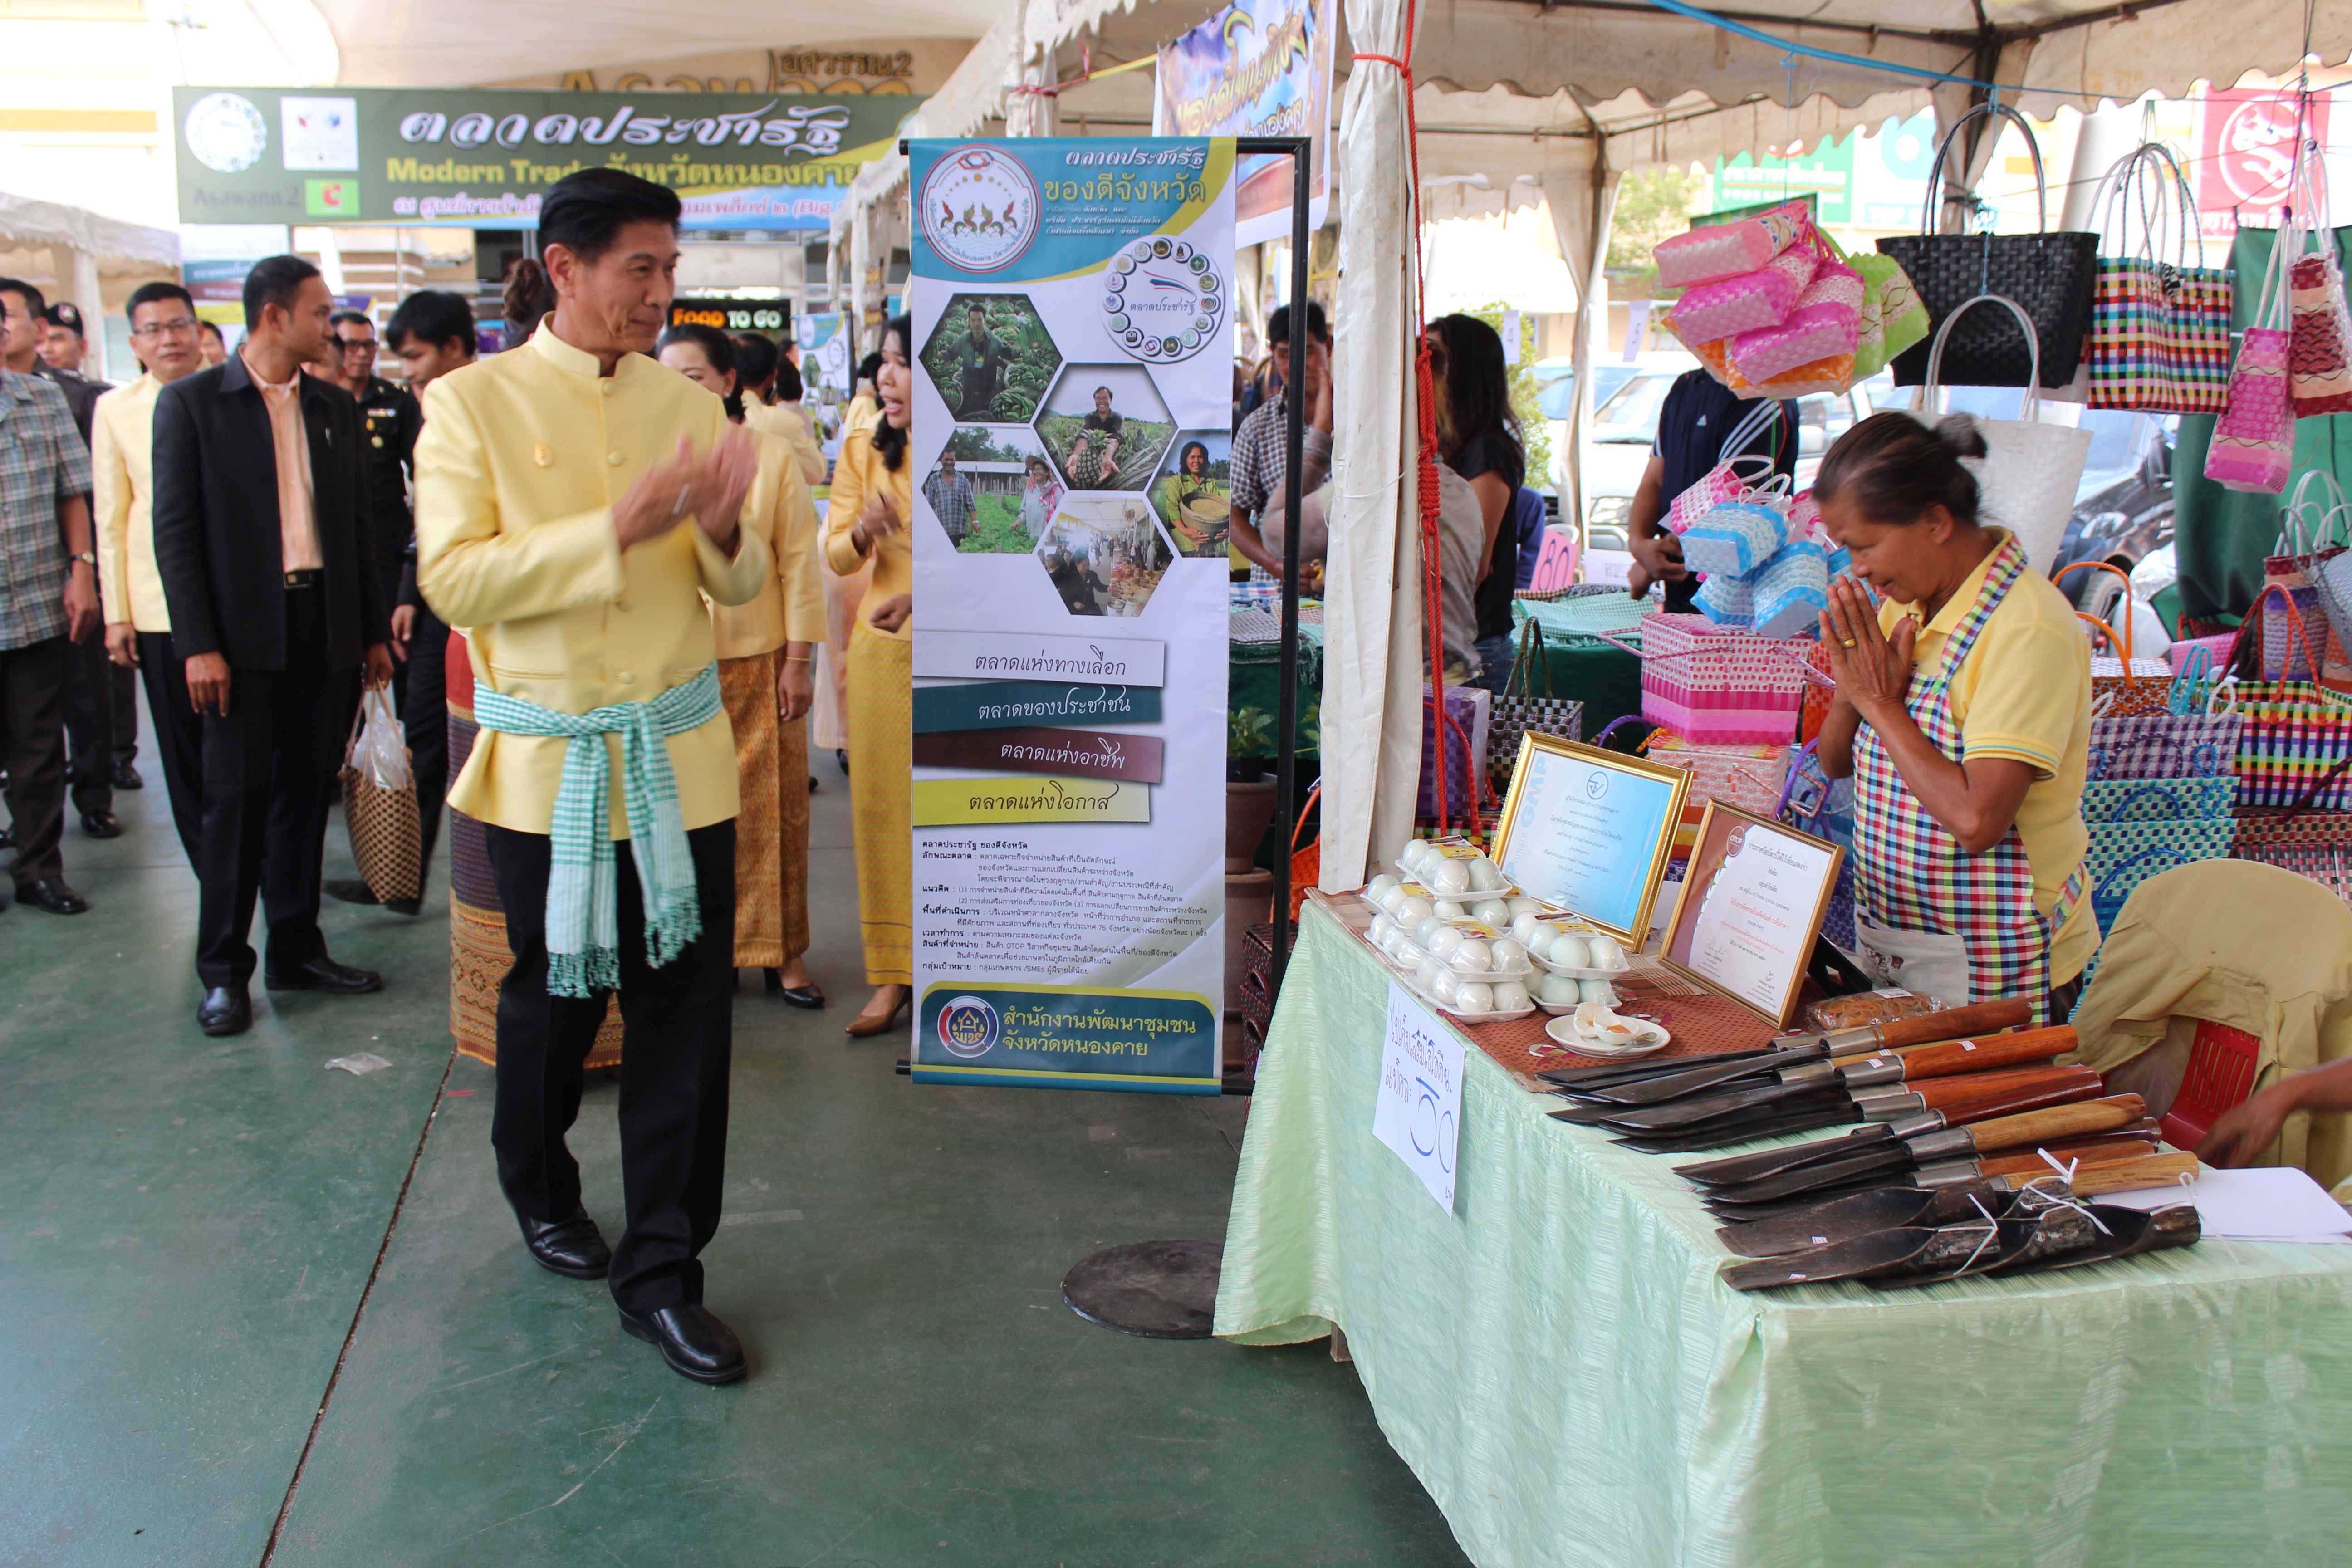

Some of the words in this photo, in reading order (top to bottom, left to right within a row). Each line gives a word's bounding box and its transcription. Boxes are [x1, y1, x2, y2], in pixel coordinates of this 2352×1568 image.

[400, 98, 852, 157] ตลาดประชารัฐ
[1066, 144, 1205, 170] ตลาดประชารัฐ
[386, 157, 505, 183] Modern
[510, 159, 594, 184] Trad
[1044, 172, 1206, 201] ของดีจังหวัด
[673, 308, 725, 328] FOOD
[727, 310, 752, 329] TO
[753, 309, 782, 329] GO
[1130, 296, 1196, 315] ตลาดประชารัฐ
[1539, 539, 1570, 590] 80
[975, 644, 1126, 676] ตลาดแห่งทางเลือก
[978, 685, 1131, 720] ตลาดของประชาชน
[1000, 737, 1125, 769] ตลาดแห่งอาชีพ
[970, 780, 1120, 811] ตลาดแห่งโอกาส
[922, 840, 976, 850] ตลาดประชารัฐ
[980, 841, 1028, 849] ของดีจังหวัด
[1730, 834, 1743, 844] OTOP
[922, 851, 972, 859] ลักษณะตลาด
[1505, 833, 1529, 879] Primary
[922, 884, 949, 892] แนวคิด
[958, 886, 967, 894] (1)
[922, 904, 980, 915] พื้นที่ดำเนินการ
[922, 928, 964, 936] เวลาทำการ
[1063, 921, 1096, 930] ทั่วประเทศ
[922, 938, 978, 948] สินค้าที่จำหน่าย
[986, 941, 1003, 949] สินค้า
[1027, 942, 1071, 952] วิสาหกิจชุมชน
[922, 962, 971, 971] กลุ่มเป้าหมาย
[979, 964, 1021, 973] กลุ่มเกษตรกร
[1003, 1005, 1196, 1039] สำนักงานพัฒนาชุมชน
[1002, 1029, 1148, 1056] จังหวัดหนองคาย
[1410, 1076, 1454, 1174] 50
